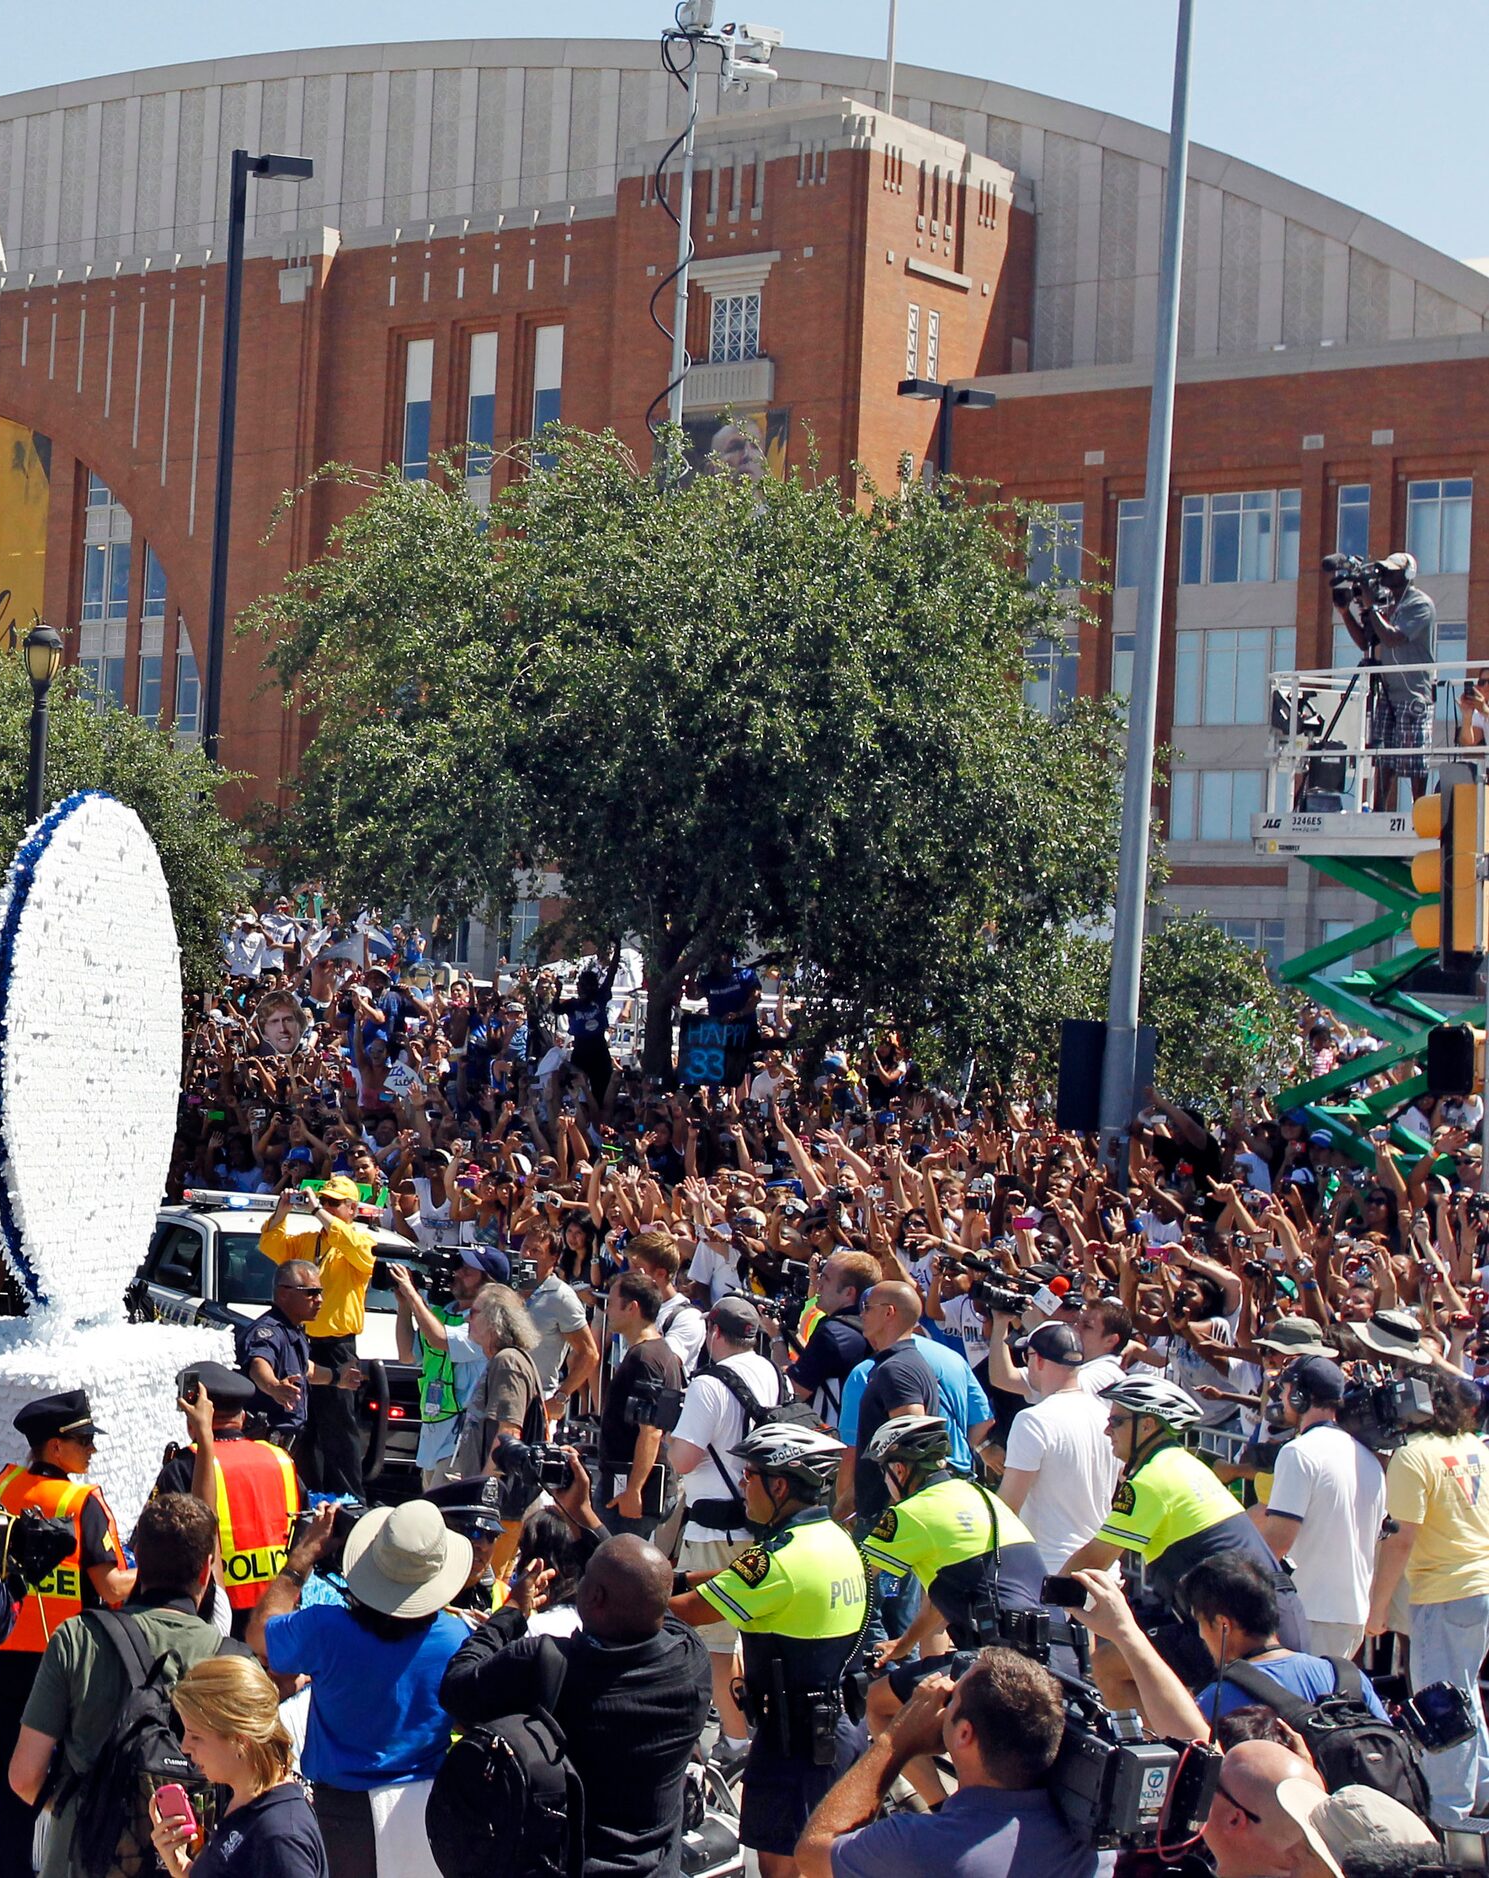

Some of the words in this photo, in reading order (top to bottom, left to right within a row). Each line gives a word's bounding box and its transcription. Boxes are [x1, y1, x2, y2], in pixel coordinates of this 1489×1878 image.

[1262, 819, 1282, 829] JLG
[688, 1023, 749, 1047] HAPPY
[1144, 1406, 1174, 1416] POLICE
[878, 1430, 902, 1453] POLICE
[772, 1445, 806, 1463] POLICE
[163, 1757, 188, 1767] Canon
